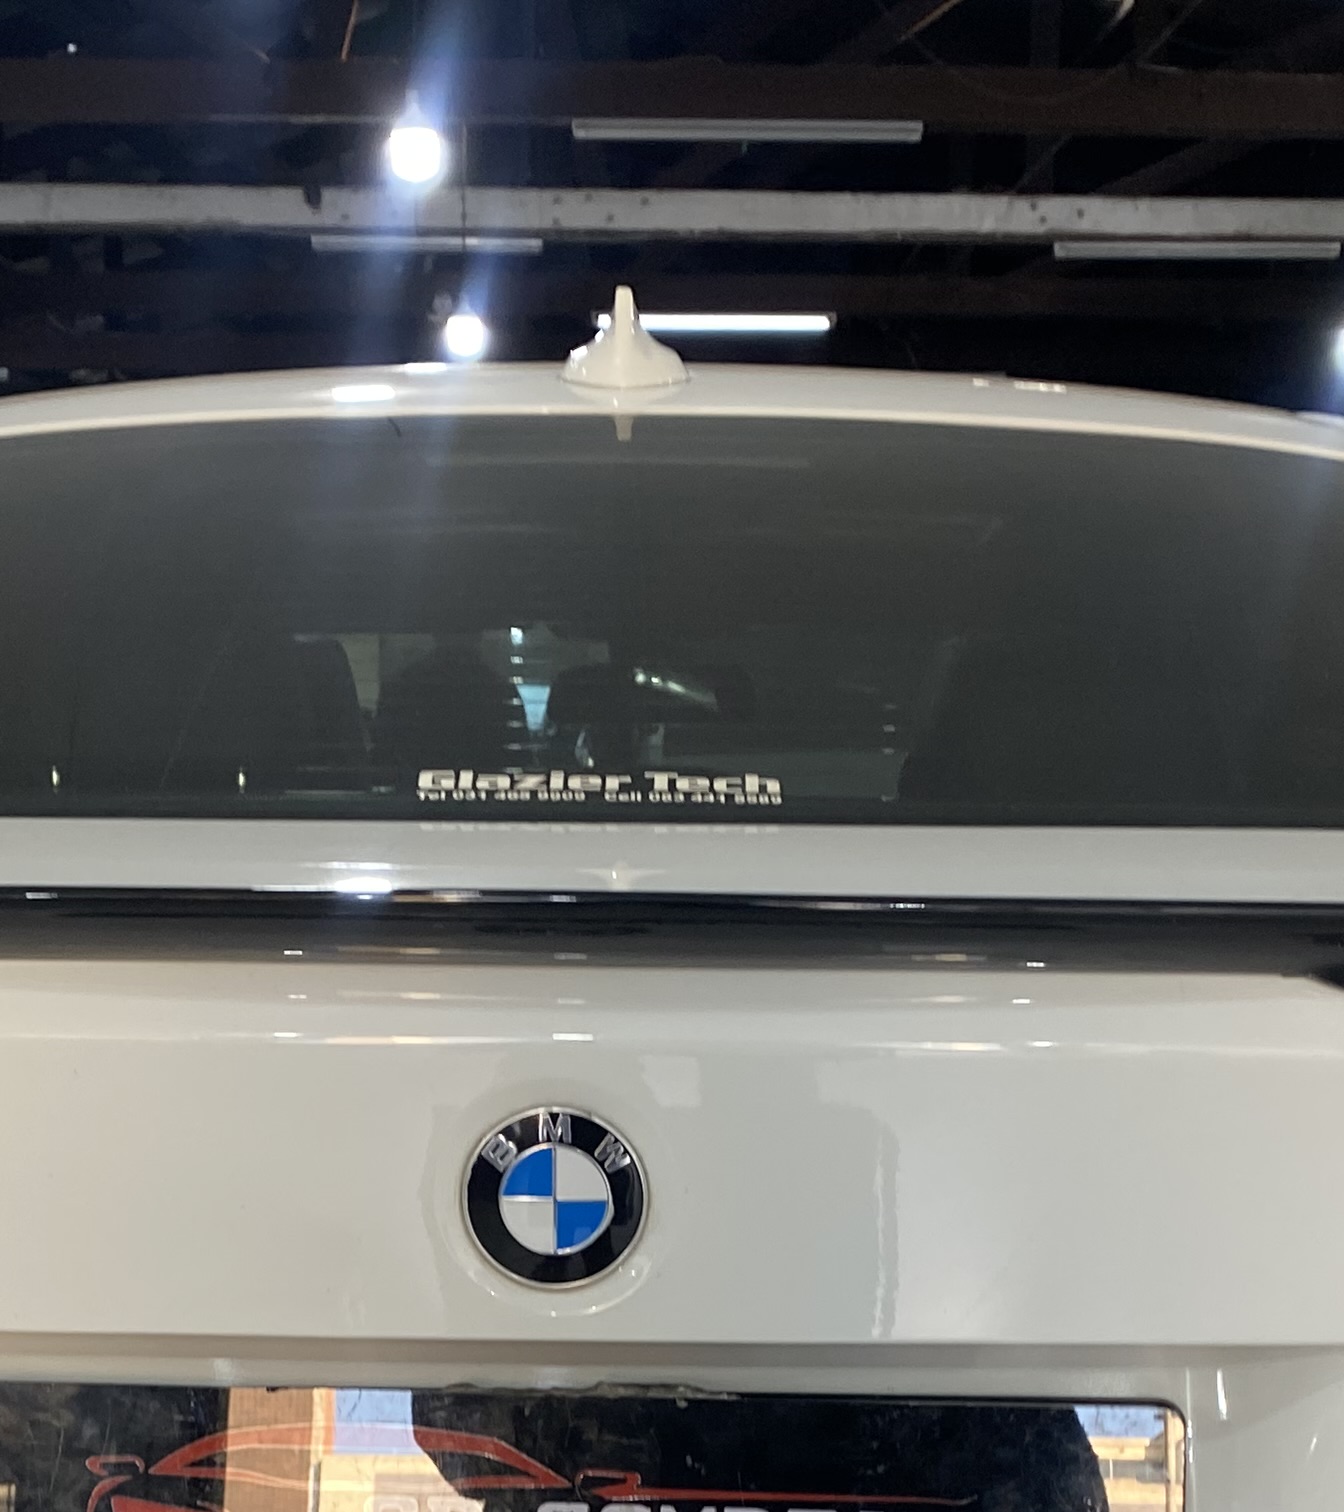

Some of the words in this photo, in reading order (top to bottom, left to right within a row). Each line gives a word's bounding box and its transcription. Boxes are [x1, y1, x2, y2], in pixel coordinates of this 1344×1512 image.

[417, 768, 632, 793] Glazier
[644, 770, 782, 794] Tech
[481, 1112, 631, 1174] BMW
